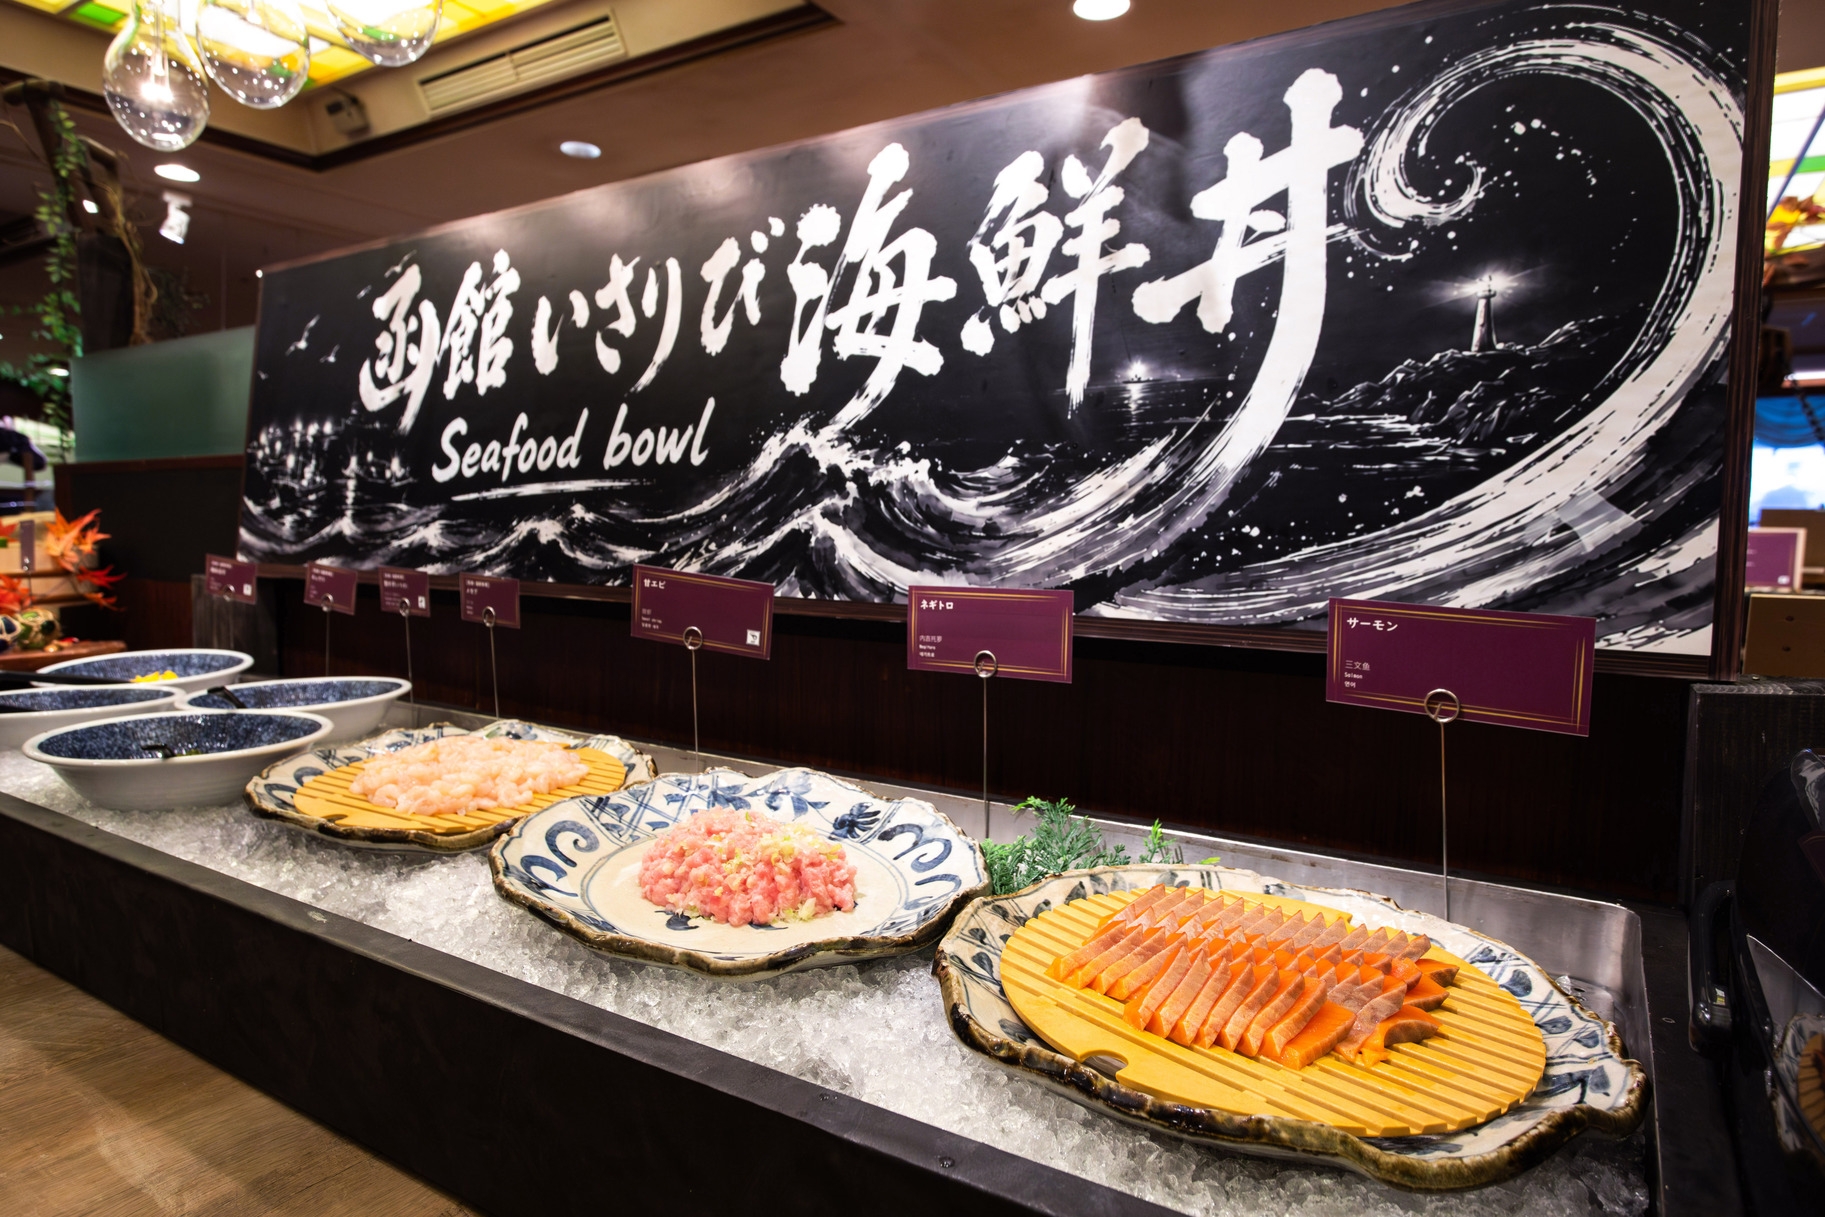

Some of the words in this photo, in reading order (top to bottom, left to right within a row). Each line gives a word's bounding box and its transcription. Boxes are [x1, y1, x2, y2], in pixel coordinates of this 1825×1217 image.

[431, 407, 589, 483] Seafood
[603, 396, 715, 471] bowl
[643, 578, 666, 590] 甘エビ
[920, 598, 954, 610] ネギトロ
[1346, 617, 1398, 632] サーモン
